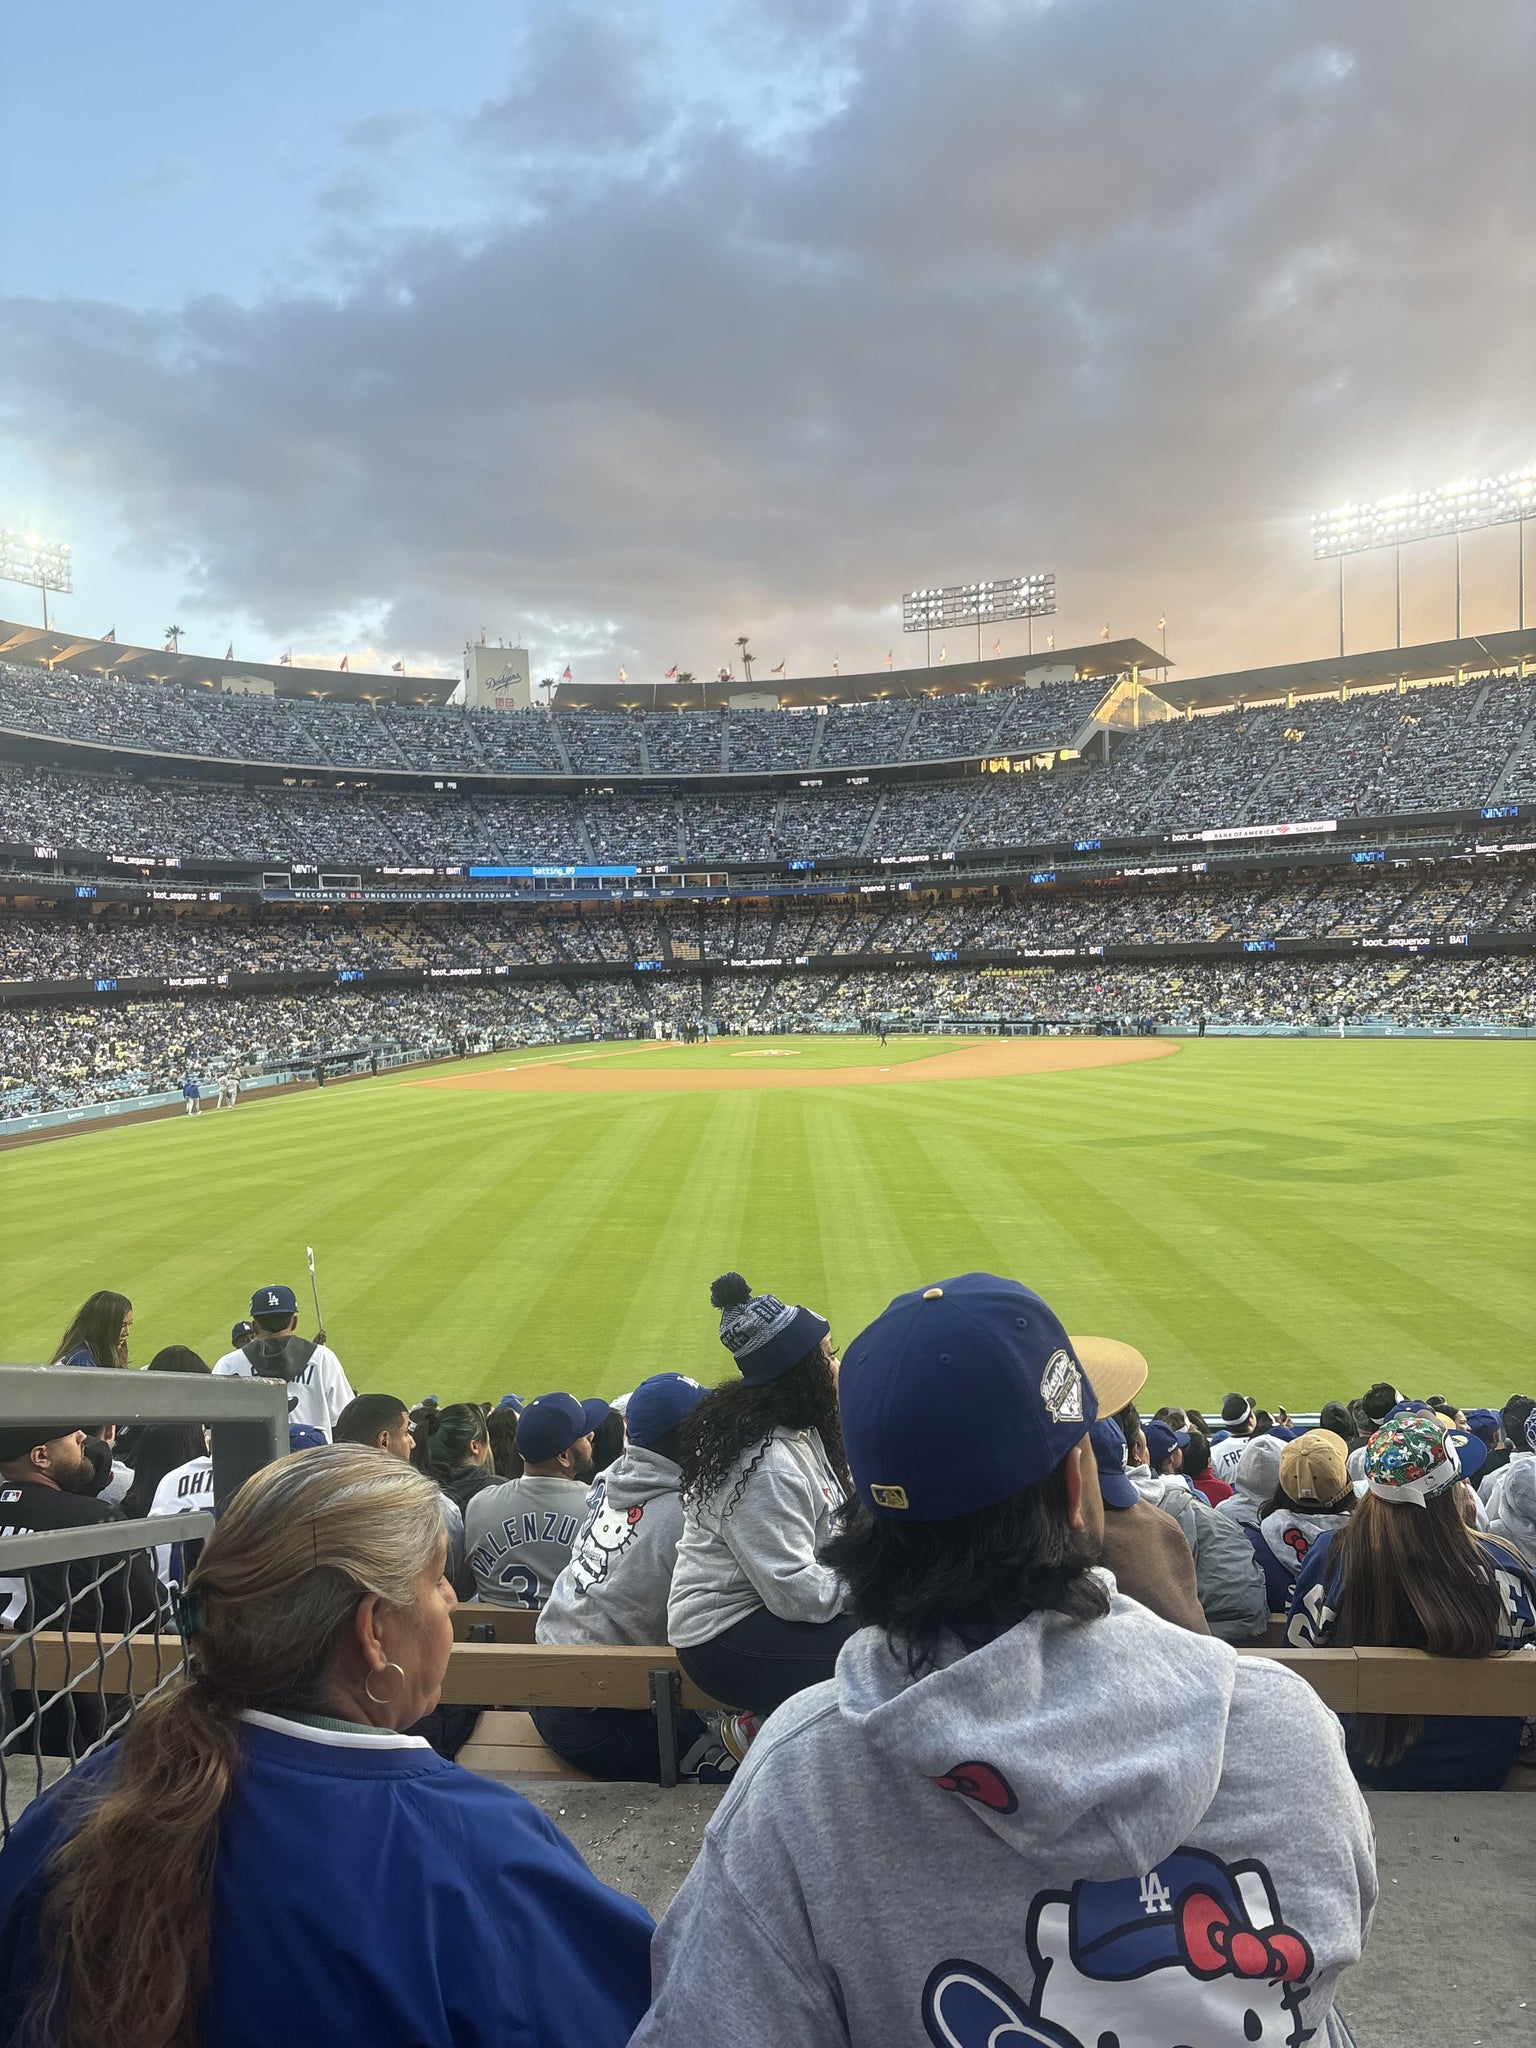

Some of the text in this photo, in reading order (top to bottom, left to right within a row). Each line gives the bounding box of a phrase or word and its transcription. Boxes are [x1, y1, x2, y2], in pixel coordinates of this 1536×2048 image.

[485, 672, 522, 690] Dodgers
[1480, 806, 1519, 819] NINTH
[1244, 829, 1275, 837] AMERICA
[1074, 841, 1101, 850] NINTH
[881, 854, 930, 864] boot_sequence
[1351, 851, 1385, 862] NINTH
[789, 861, 815, 870] NINTH
[1124, 866, 1178, 876] boot_sequence
[1031, 874, 1056, 883] NINTH
[75, 886, 97, 897] NINTH
[153, 891, 198, 901] boot_sequence
[1362, 937, 1431, 948] boot_sequence
[1449, 935, 1465, 945] BAT
[1243, 942, 1276, 952] NINTH
[931, 952, 958, 961] NINTH
[1024, 948, 1076, 958] boot_sequence
[634, 961, 662, 970] NINTH
[731, 957, 782, 967] boot_sequence
[338, 971, 364, 981] NINTH
[431, 967, 482, 977] boot_sequence
[169, 976, 208, 987] boot_sequence
[267, 1291, 280, 1306] LA
[472, 1511, 579, 1578] VALENZU
[1139, 1871, 1173, 1914] LA
